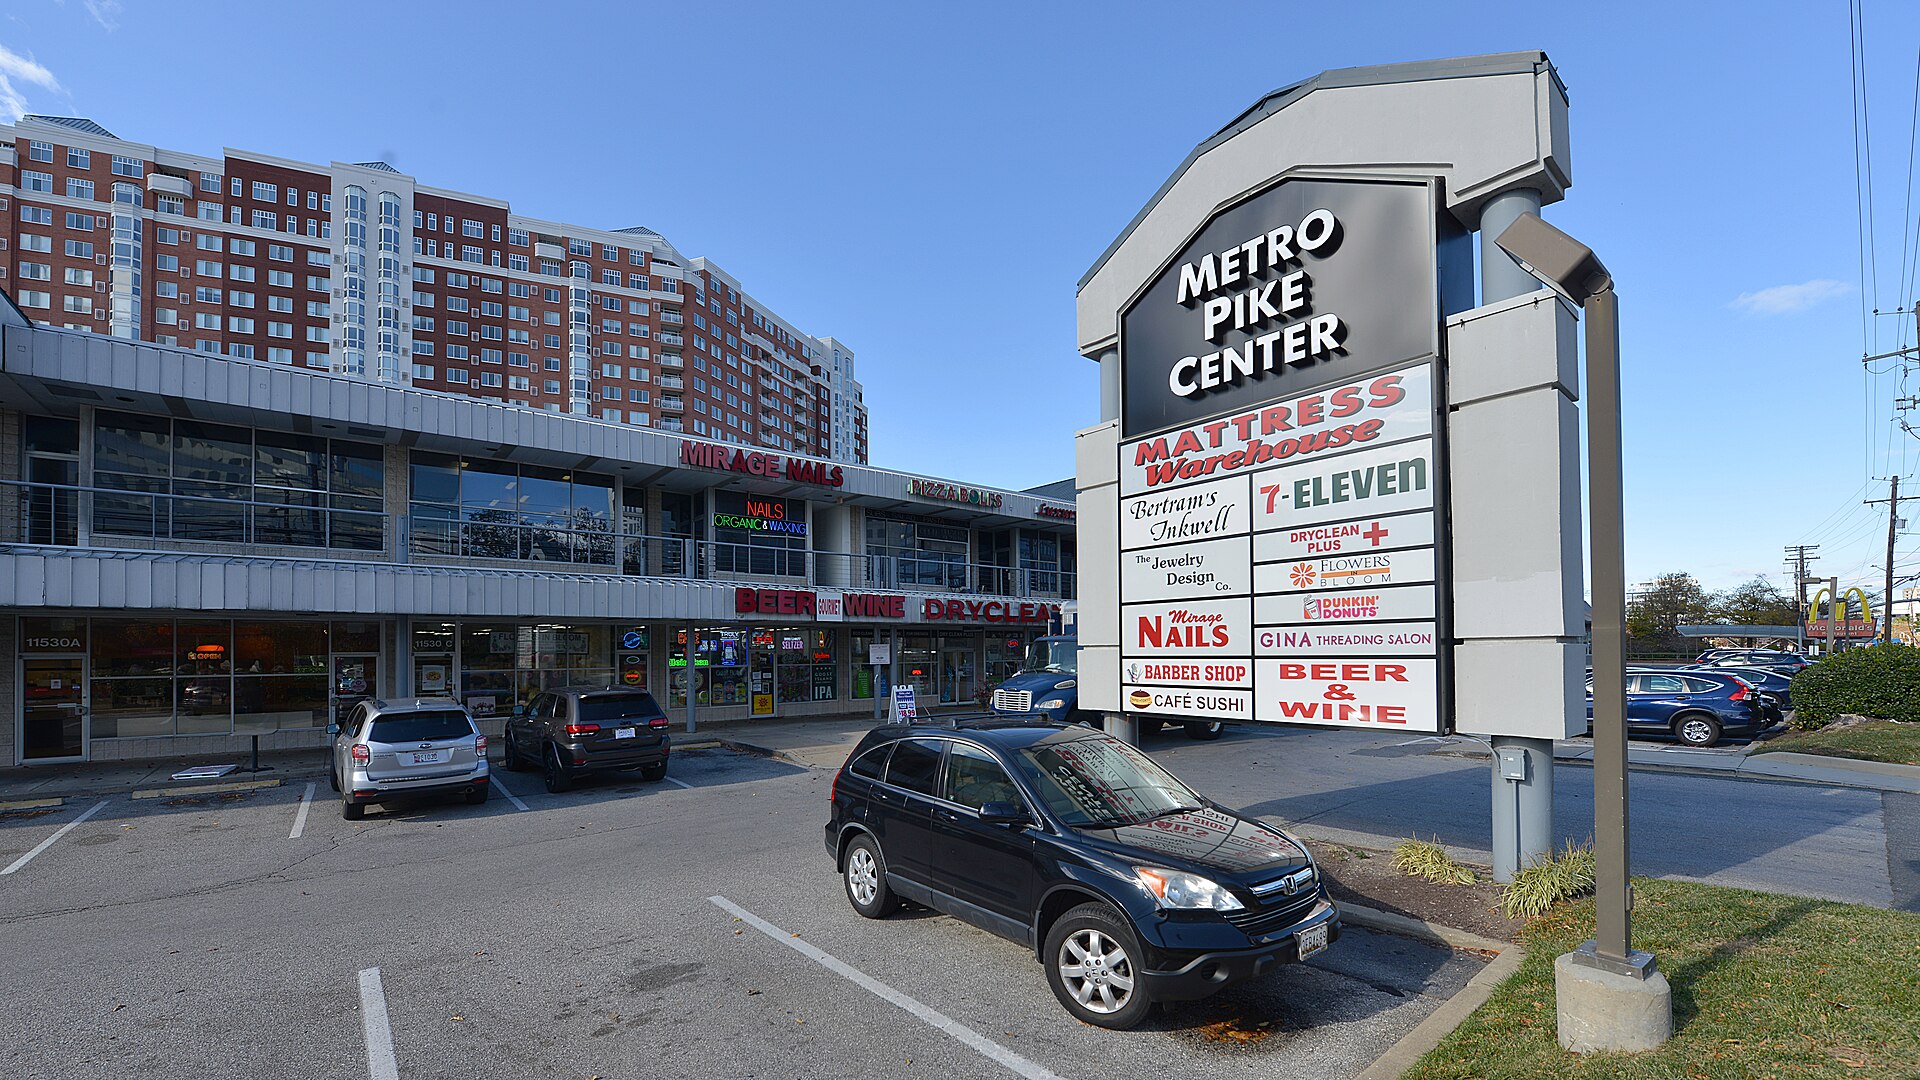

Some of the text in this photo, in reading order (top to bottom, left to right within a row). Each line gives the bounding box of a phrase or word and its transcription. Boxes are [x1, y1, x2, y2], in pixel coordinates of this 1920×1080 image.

[1176, 208, 1337, 305] METRO
[1203, 269, 1305, 342] PIKE
[1168, 313, 1342, 398] CENTER
[1135, 374, 1406, 467] MATTRESS
[1145, 417, 1385, 487] Warehouse
[681, 440, 844, 487] MIRAGE NAILS
[908, 479, 956, 500] PIZZA
[747, 501, 783, 519] NAILS
[1130, 490, 1218, 520] Bertram's
[714, 514, 807, 535] ORGANIC & WAXING
[1150, 504, 1235, 542] Inkwell
[1290, 524, 1360, 544] DRYCLEAN
[1307, 539, 1342, 553] PLUS
[1135, 553, 1205, 571] The Jewelry
[1320, 555, 1391, 572] FLOWERS
[1166, 570, 1215, 587] Design
[1215, 581, 1232, 591] Co.
[735, 587, 816, 615] BEER
[818, 598, 841, 616] GOURMET
[843, 593, 906, 618] WINE
[1323, 595, 1380, 609] DUNKIN'
[925, 598, 1062, 624] DRYCLEA
[1168, 609, 1224, 625] Mirage
[1323, 606, 1379, 619] DONUTS
[1138, 615, 1229, 648] NAILS
[1260, 631, 1432, 648] GINA THREADING SALON
[26, 638, 80, 648] 11530A
[415, 639, 454, 648] 11530 C
[782, 640, 804, 650] SELTZER
[1144, 665, 1246, 682] BARBER SHOP
[1279, 664, 1409, 682] BEER
[814, 686, 833, 700] IPA
[1323, 683, 1356, 701] &
[1153, 692, 1244, 712] CAFÉ SUSHI
[1279, 701, 1407, 725] WINE
